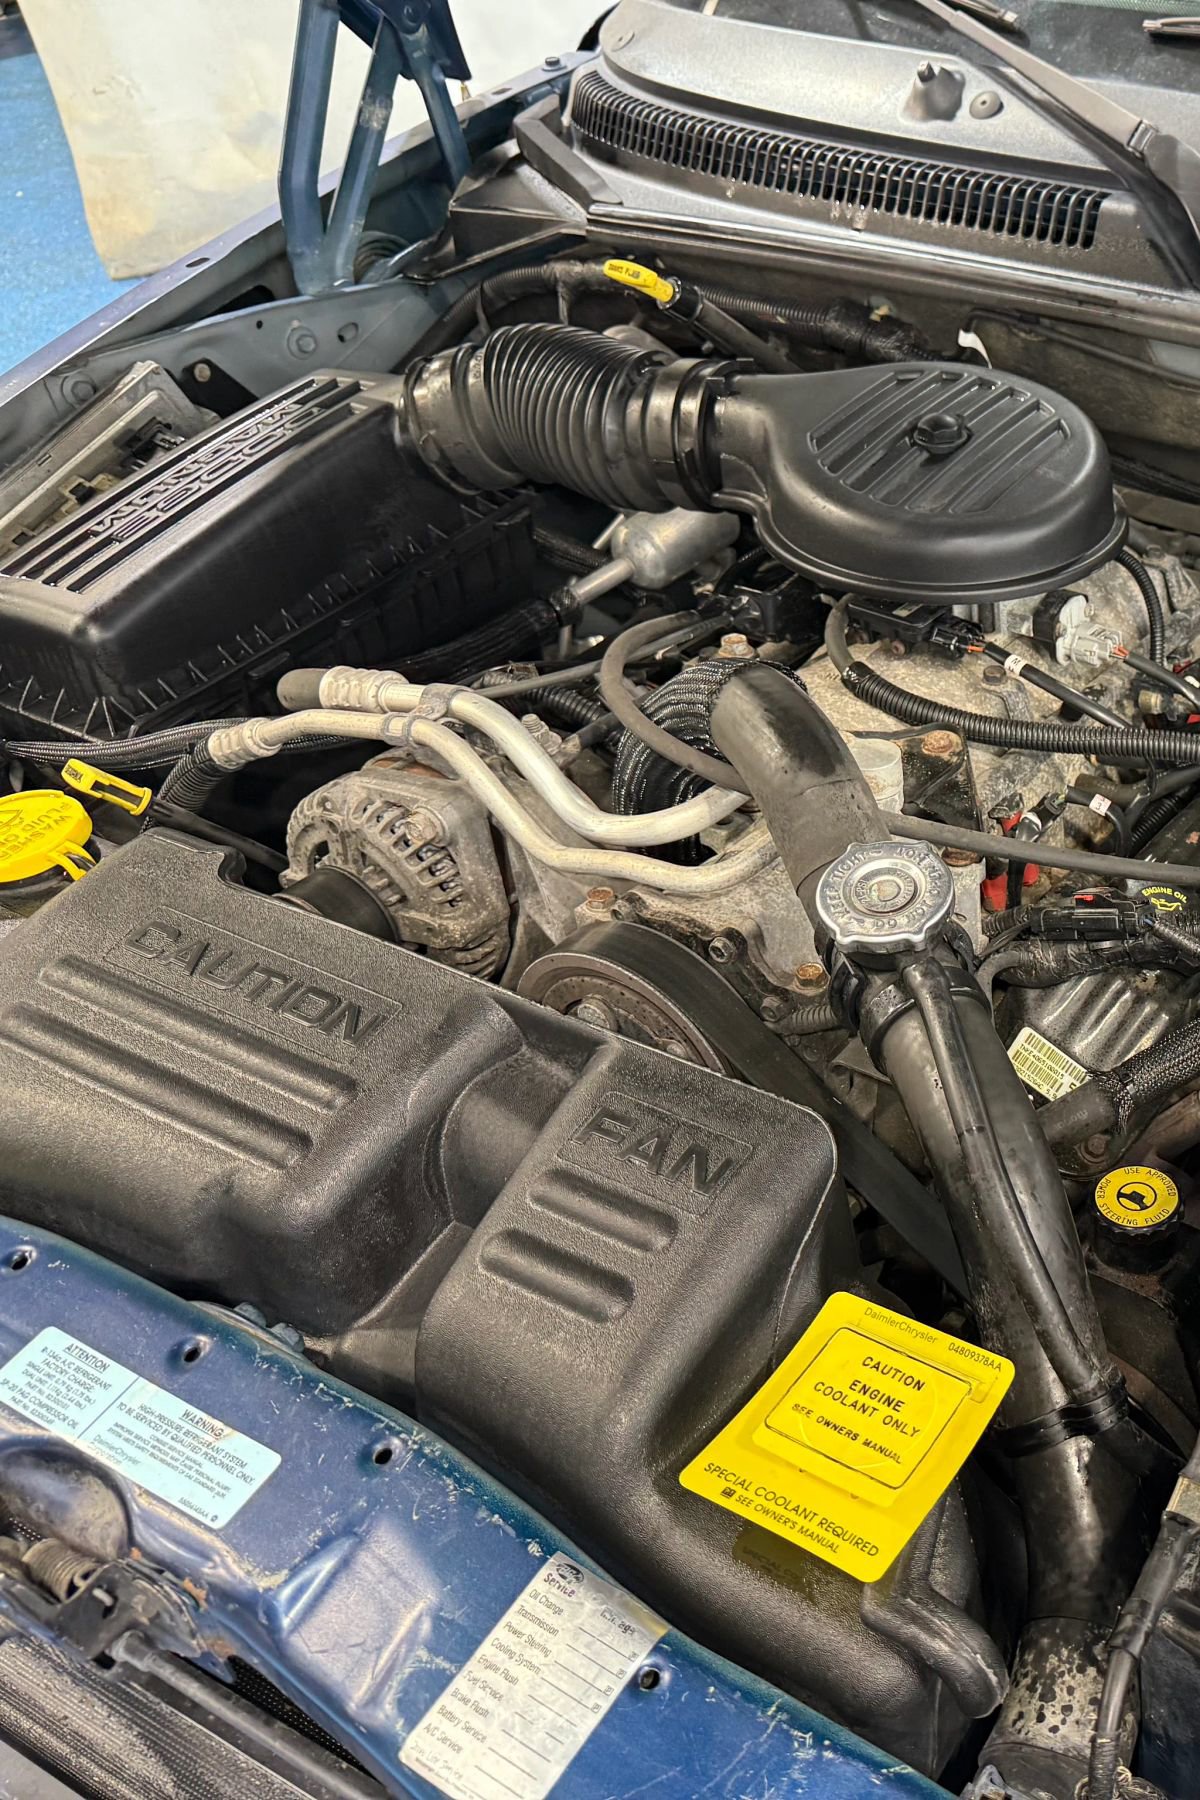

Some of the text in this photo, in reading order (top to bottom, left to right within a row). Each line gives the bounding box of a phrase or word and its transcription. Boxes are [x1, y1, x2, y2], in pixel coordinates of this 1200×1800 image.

[90, 404, 303, 535] MAGNUM
[110, 405, 324, 544] DODGE
[1141, 886, 1188, 904] ENGINE OIL
[122, 918, 387, 1047] CAUTION
[571, 1104, 735, 1198] FAN
[1097, 1178, 1170, 1226] POWER STEERING FLUID
[1146, 1169, 1177, 1197] APPROVED
[861, 1307, 939, 1345] DaimlerChrysler
[40, 1357, 70, 1378] FACTORY
[64, 1342, 110, 1372] ATTENTION
[860, 1355, 926, 1391] CAUTION
[72, 1365, 111, 1391] REFRIGERANT
[847, 1379, 906, 1412] ENGINE
[27, 1394, 69, 1422] COMPRESSOR
[811, 1380, 920, 1439] COOLANT ONLY
[116, 1401, 127, 1411] TO
[124, 1406, 135, 1416] BE
[132, 1411, 163, 1432] SERVICED
[160, 1427, 172, 1437] BY
[169, 1432, 202, 1455] QUALIFIED
[199, 1450, 237, 1475] PERSONNEL
[137, 1402, 184, 1433] HIGH-PRESSURE
[182, 1428, 224, 1456] REFRIGERANT
[221, 1451, 248, 1469] SYSTEM
[790, 1402, 905, 1464] SEE OWNERS MANUAL
[703, 1461, 881, 1558] SPECIAL COOLANT REQUIRED
[734, 1493, 841, 1553] SEE OWNER'S MANUAL
[528, 1588, 565, 1617] Oil Change
[542, 1572, 577, 1598] Service
[502, 1620, 553, 1658] Power Steering
[516, 1604, 560, 1637] Transmission
[476, 1653, 520, 1686] Engine Flush
[489, 1636, 543, 1677] Cooling System
[450, 1687, 490, 1718] Brake Flush
[423, 1721, 440, 1737] A/C
[436, 1731, 464, 1755] Service
[436, 1704, 488, 1744] Battery Service
